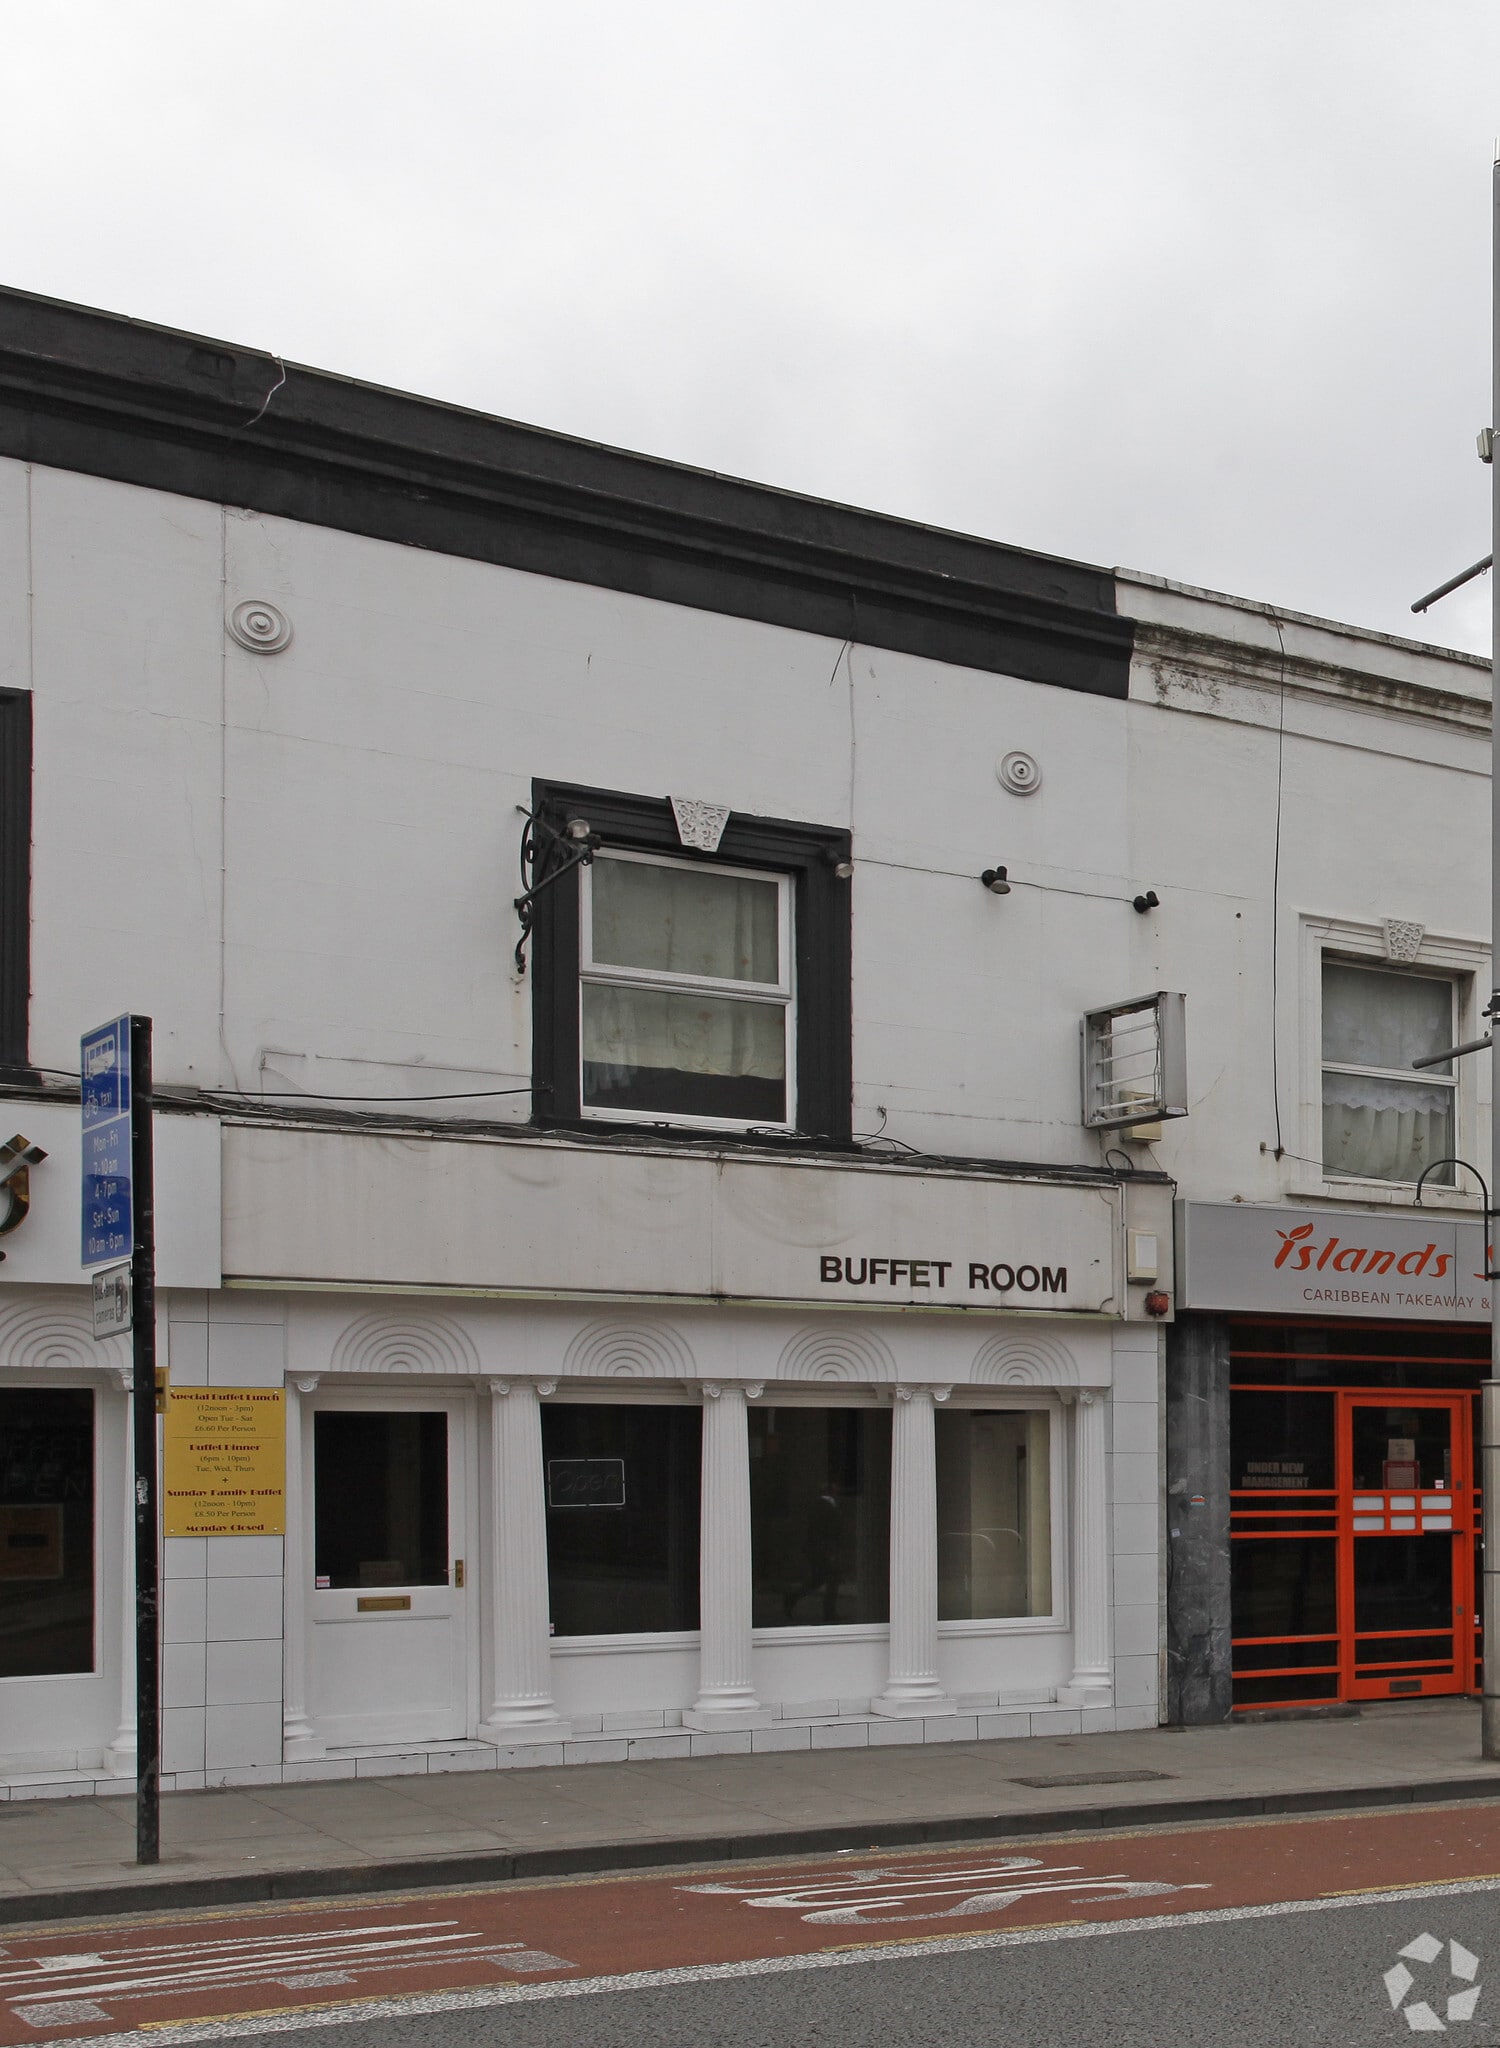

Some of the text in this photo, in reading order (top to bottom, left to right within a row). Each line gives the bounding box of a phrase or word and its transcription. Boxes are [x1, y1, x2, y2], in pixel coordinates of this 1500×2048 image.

[101, 1088, 112, 1107] taxi
[819, 1255, 1068, 1294] BUFFET ROOM
[1303, 1289, 1490, 1308] CARIBBEAN TAKEAWAY &
[170, 1393, 209, 1401] Special
[1247, 1462, 1304, 1473] UNDER NEW
[1242, 1476, 1309, 1488] MANAGEMENT
